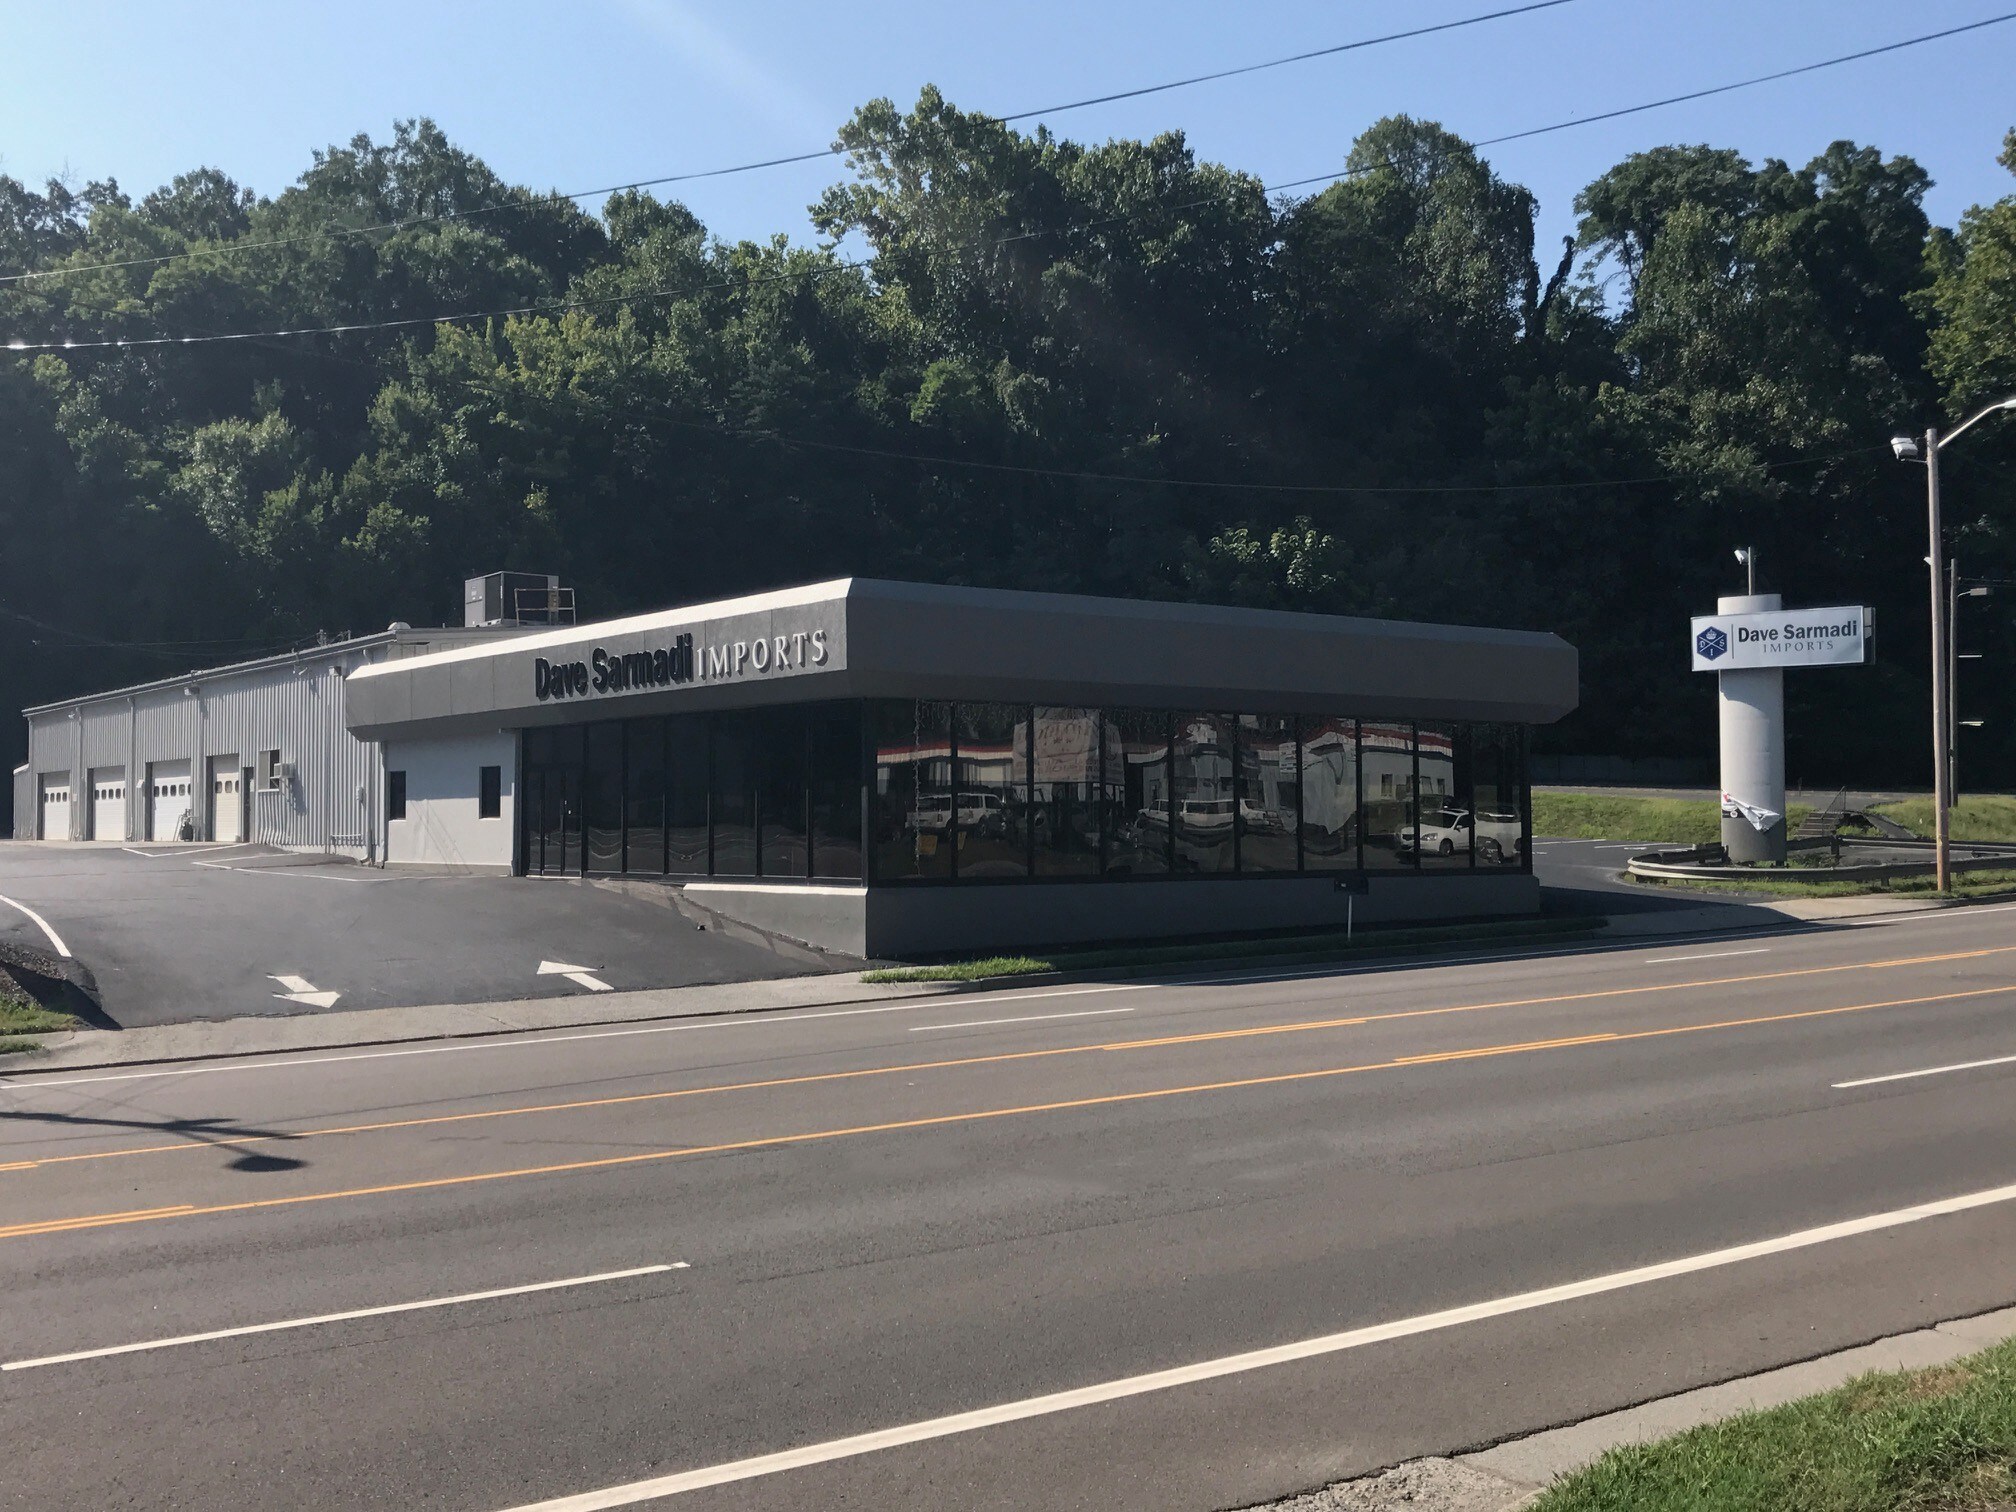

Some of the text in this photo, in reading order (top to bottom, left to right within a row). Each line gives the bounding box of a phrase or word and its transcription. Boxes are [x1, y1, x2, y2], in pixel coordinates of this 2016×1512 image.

[1738, 620, 1858, 643] Dave Sarmadi
[1763, 640, 1834, 653] IMPORTS
[535, 629, 828, 701] Dave Sarmadi IMPORTS
